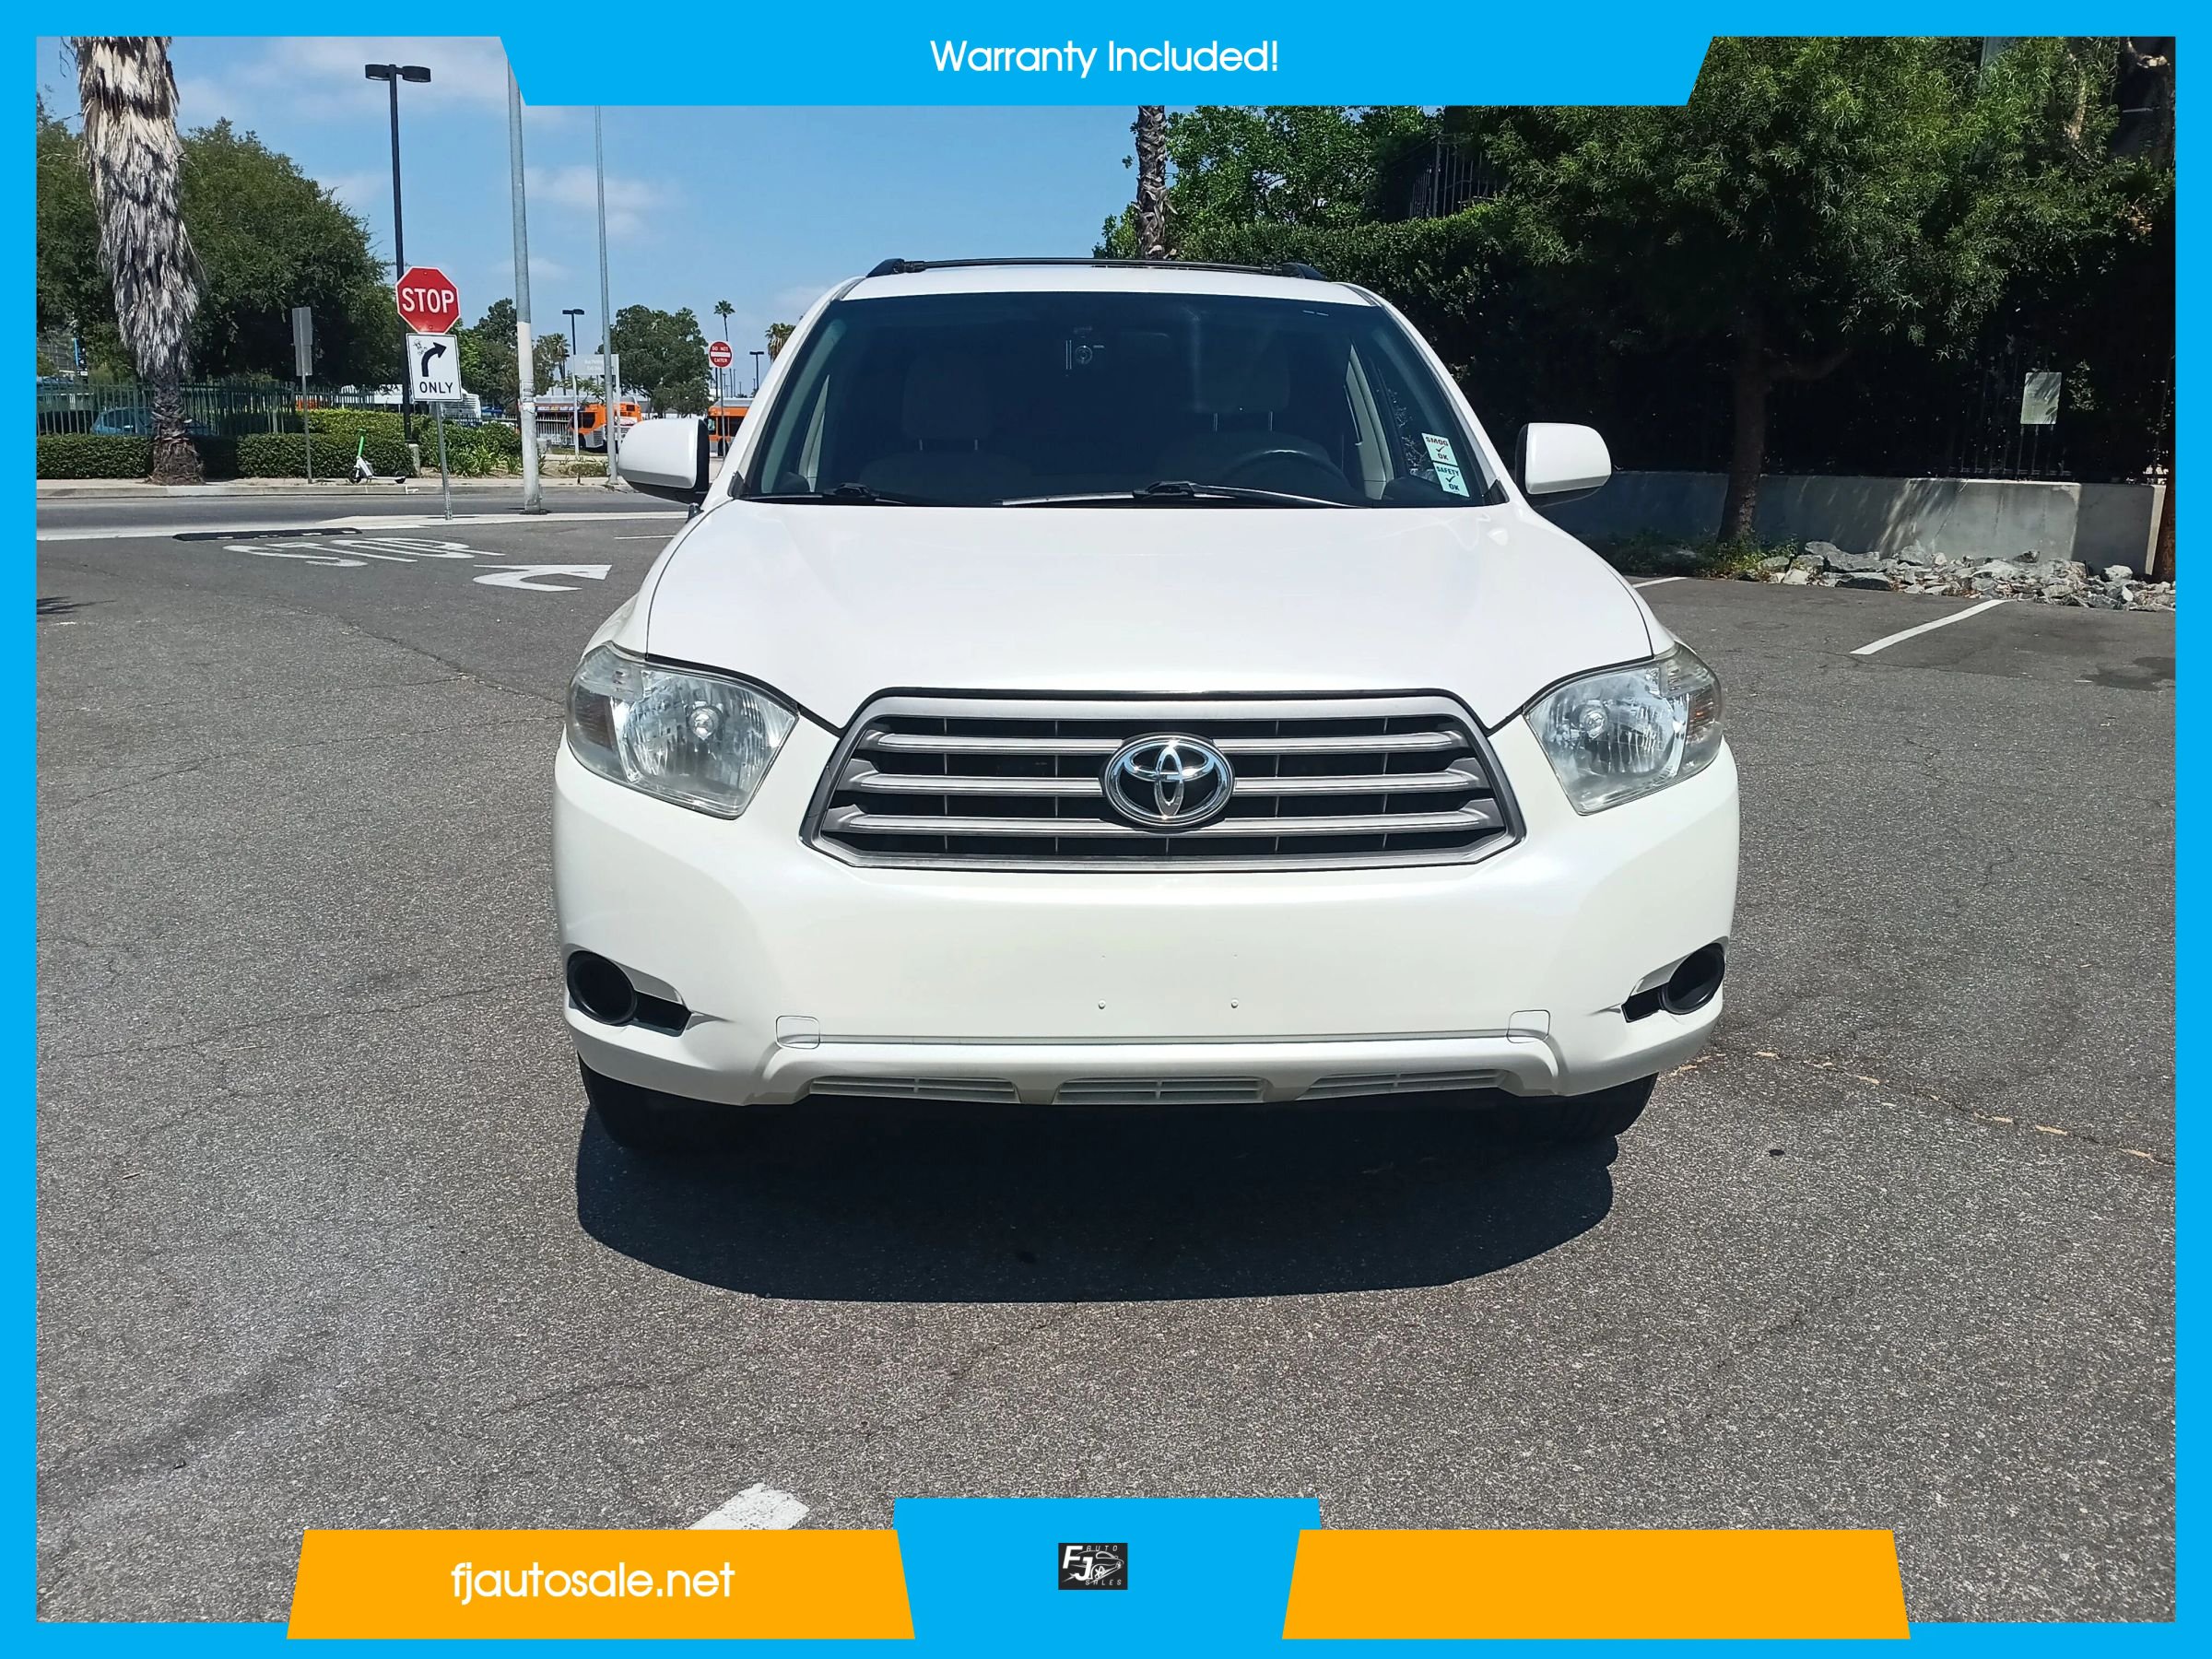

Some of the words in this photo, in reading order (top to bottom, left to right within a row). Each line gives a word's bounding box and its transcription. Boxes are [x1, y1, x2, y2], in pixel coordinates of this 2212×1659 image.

[402, 288, 454, 313] STOP
[419, 381, 453, 394] ONLY
[1426, 437, 1449, 446] SMOG
[1437, 466, 1460, 476] SAFETY
[223, 537, 505, 567] STOP
